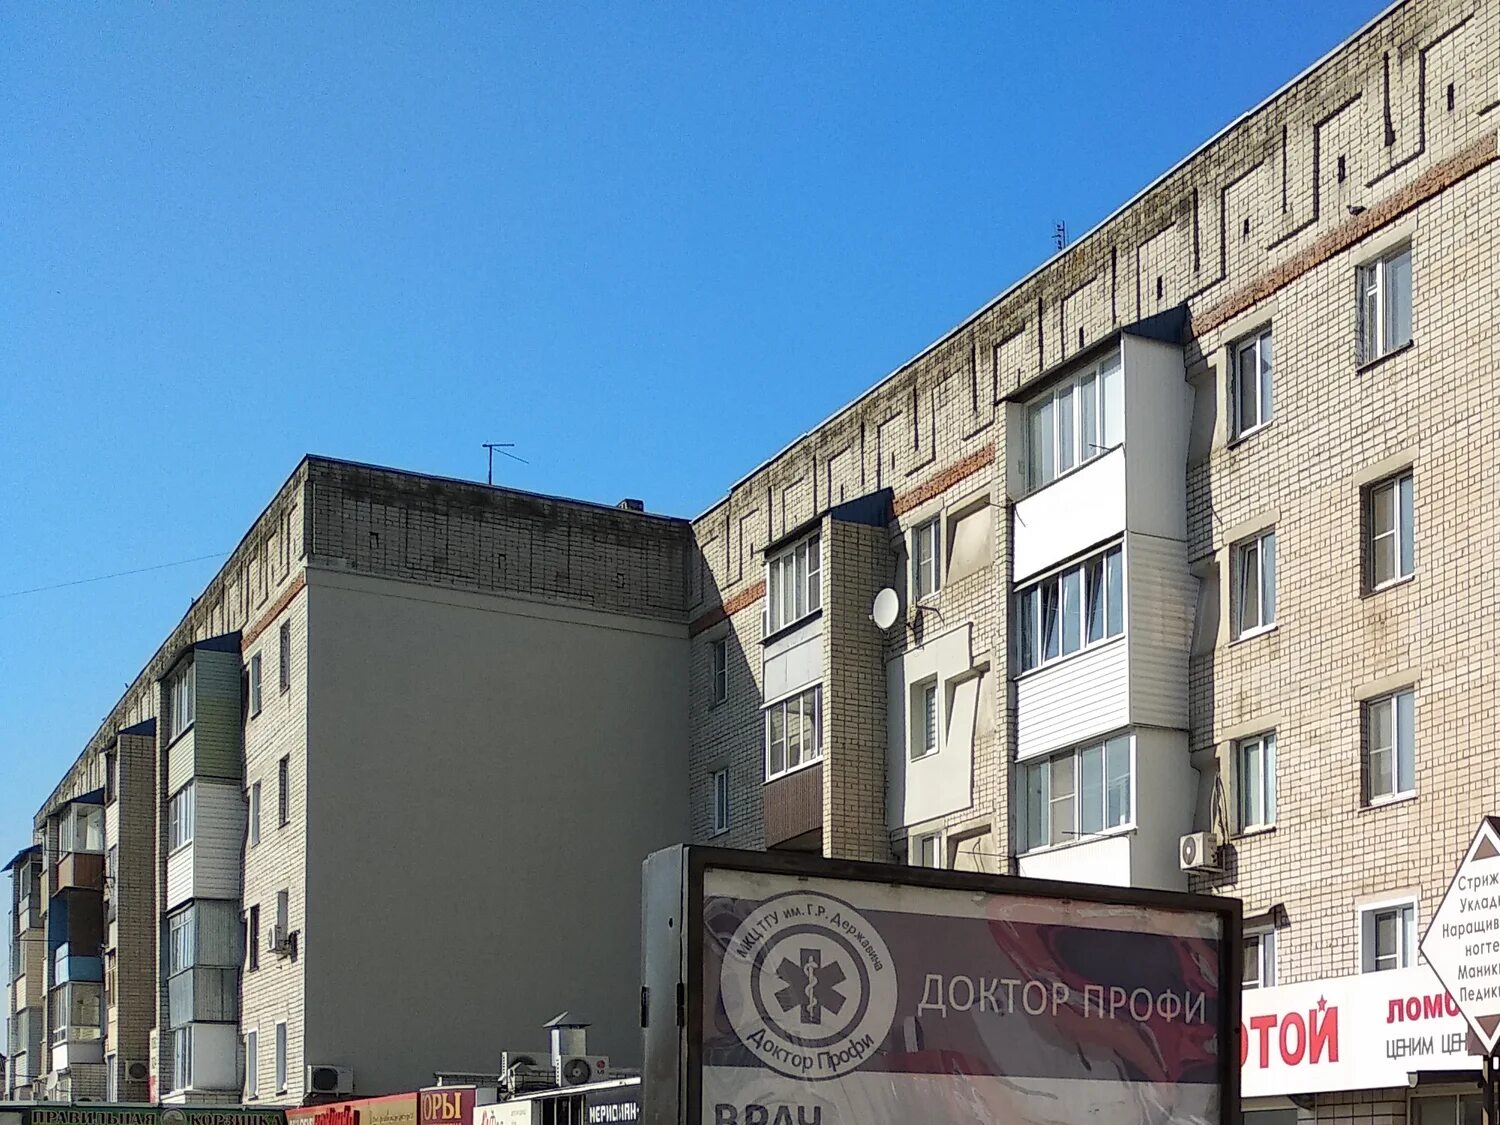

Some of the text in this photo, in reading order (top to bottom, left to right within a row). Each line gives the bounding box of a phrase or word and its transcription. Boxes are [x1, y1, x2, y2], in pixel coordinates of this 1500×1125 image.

[735, 926, 764, 959] МКЦ
[756, 911, 779, 933] ТГУ
[830, 912, 884, 972] Державина
[917, 973, 1207, 1025] ДОКТОР ПРОФИ
[746, 1027, 875, 1073] Доктор Профи
[1241, 995, 1339, 1069] ТОЙ
[1386, 1036, 1434, 1061] ЦЕНИМ
